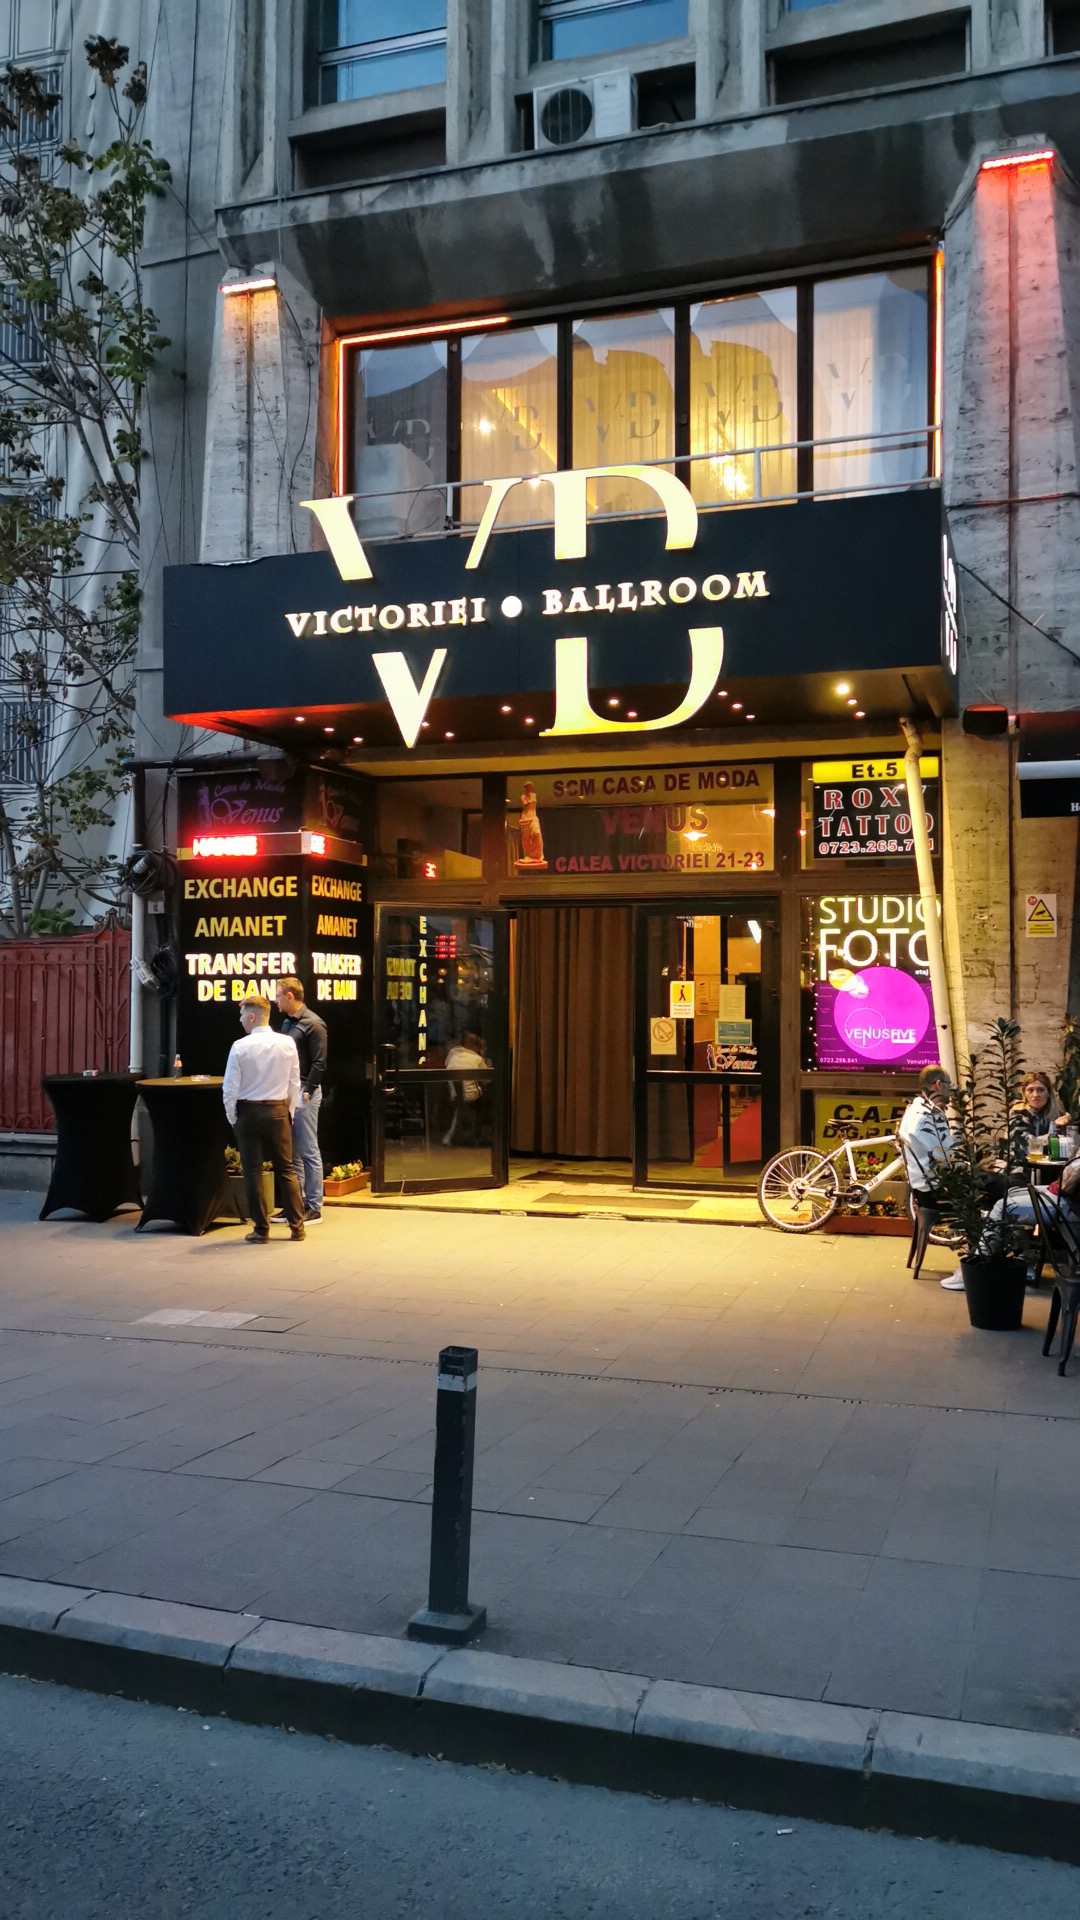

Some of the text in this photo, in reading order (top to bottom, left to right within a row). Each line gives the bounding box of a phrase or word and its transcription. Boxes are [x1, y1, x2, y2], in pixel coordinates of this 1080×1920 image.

[285, 570, 770, 638] VICTORIEI BALLROOM
[851, 762, 898, 778] Et.5
[553, 769, 759, 798] SCM CASA DE MODA
[602, 803, 708, 835] VENUS
[818, 838, 934, 854] 0723.265.71
[555, 851, 765, 872] CALEA VICTORIEI 21-23
[184, 876, 298, 900] EXCHANGE
[311, 875, 362, 901] EXCHANGE
[819, 897, 942, 924] STUDIO
[194, 915, 287, 938] AMANET
[316, 914, 358, 938] AMANET
[185, 952, 297, 975] TRANSFER
[312, 952, 362, 976] TRANSFER
[198, 979, 281, 1001] DE BAN
[317, 979, 357, 1000] DE BANI
